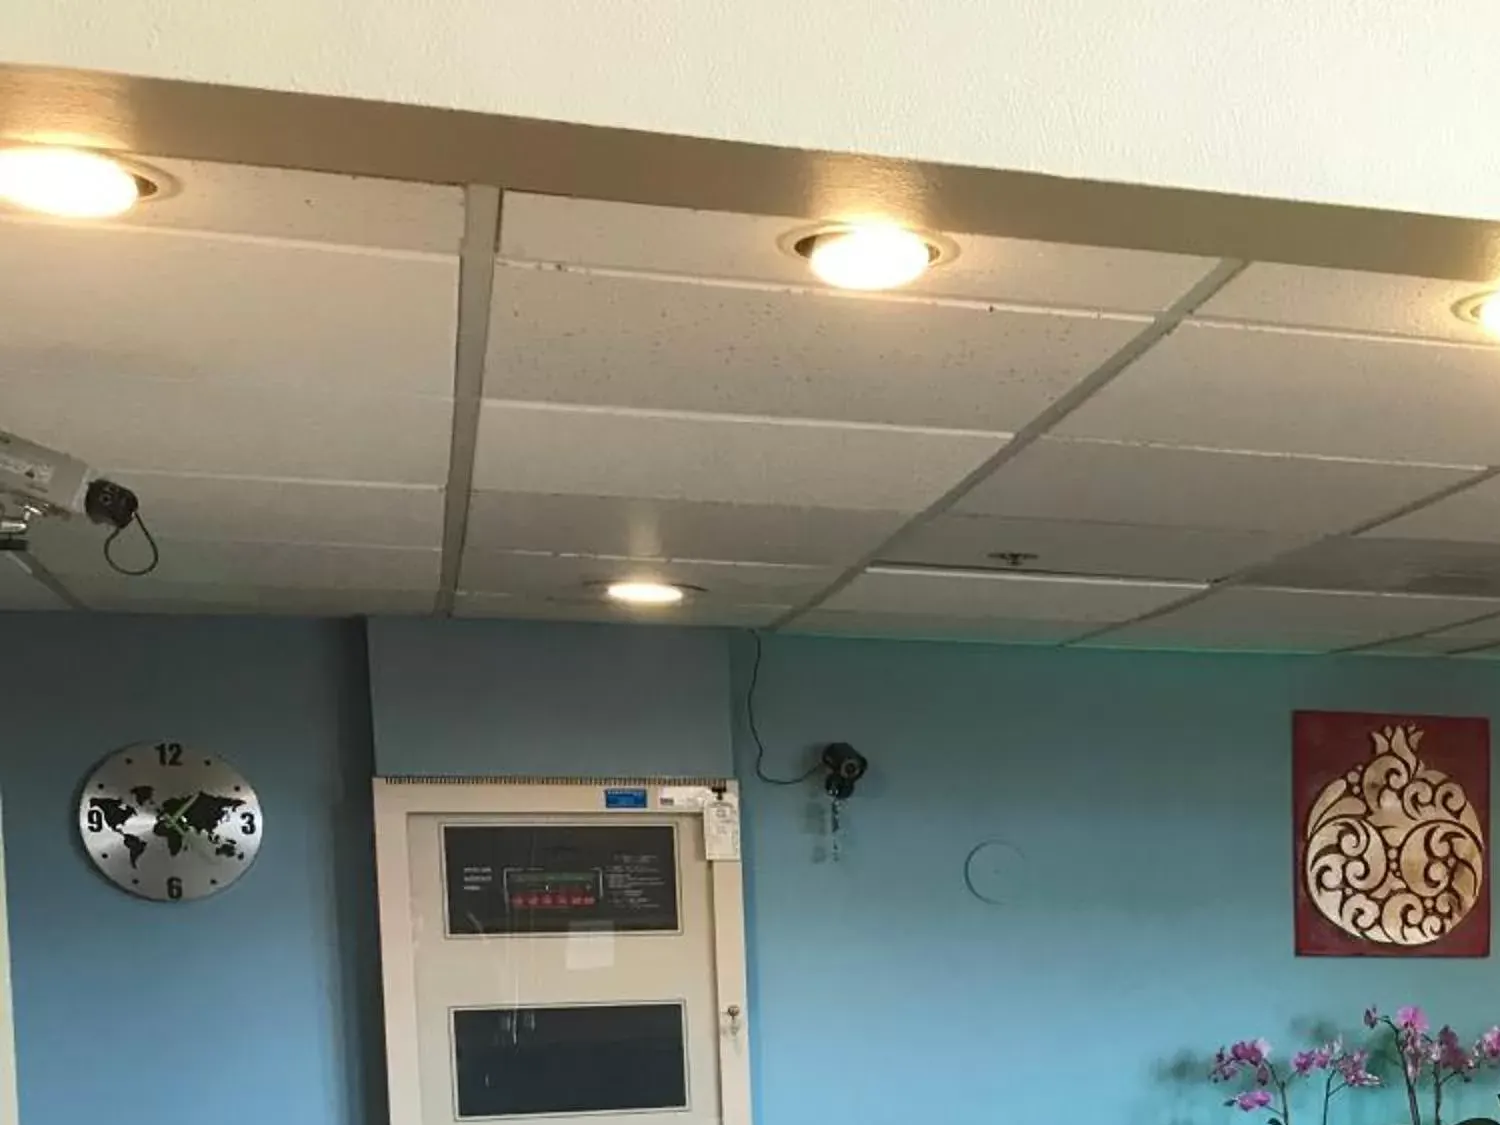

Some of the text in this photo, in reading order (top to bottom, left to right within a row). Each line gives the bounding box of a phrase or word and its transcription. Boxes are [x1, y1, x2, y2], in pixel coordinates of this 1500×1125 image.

[155, 743, 183, 766] 12
[88, 809, 103, 833] 9
[240, 812, 256, 834] 3
[167, 877, 183, 899] 6
